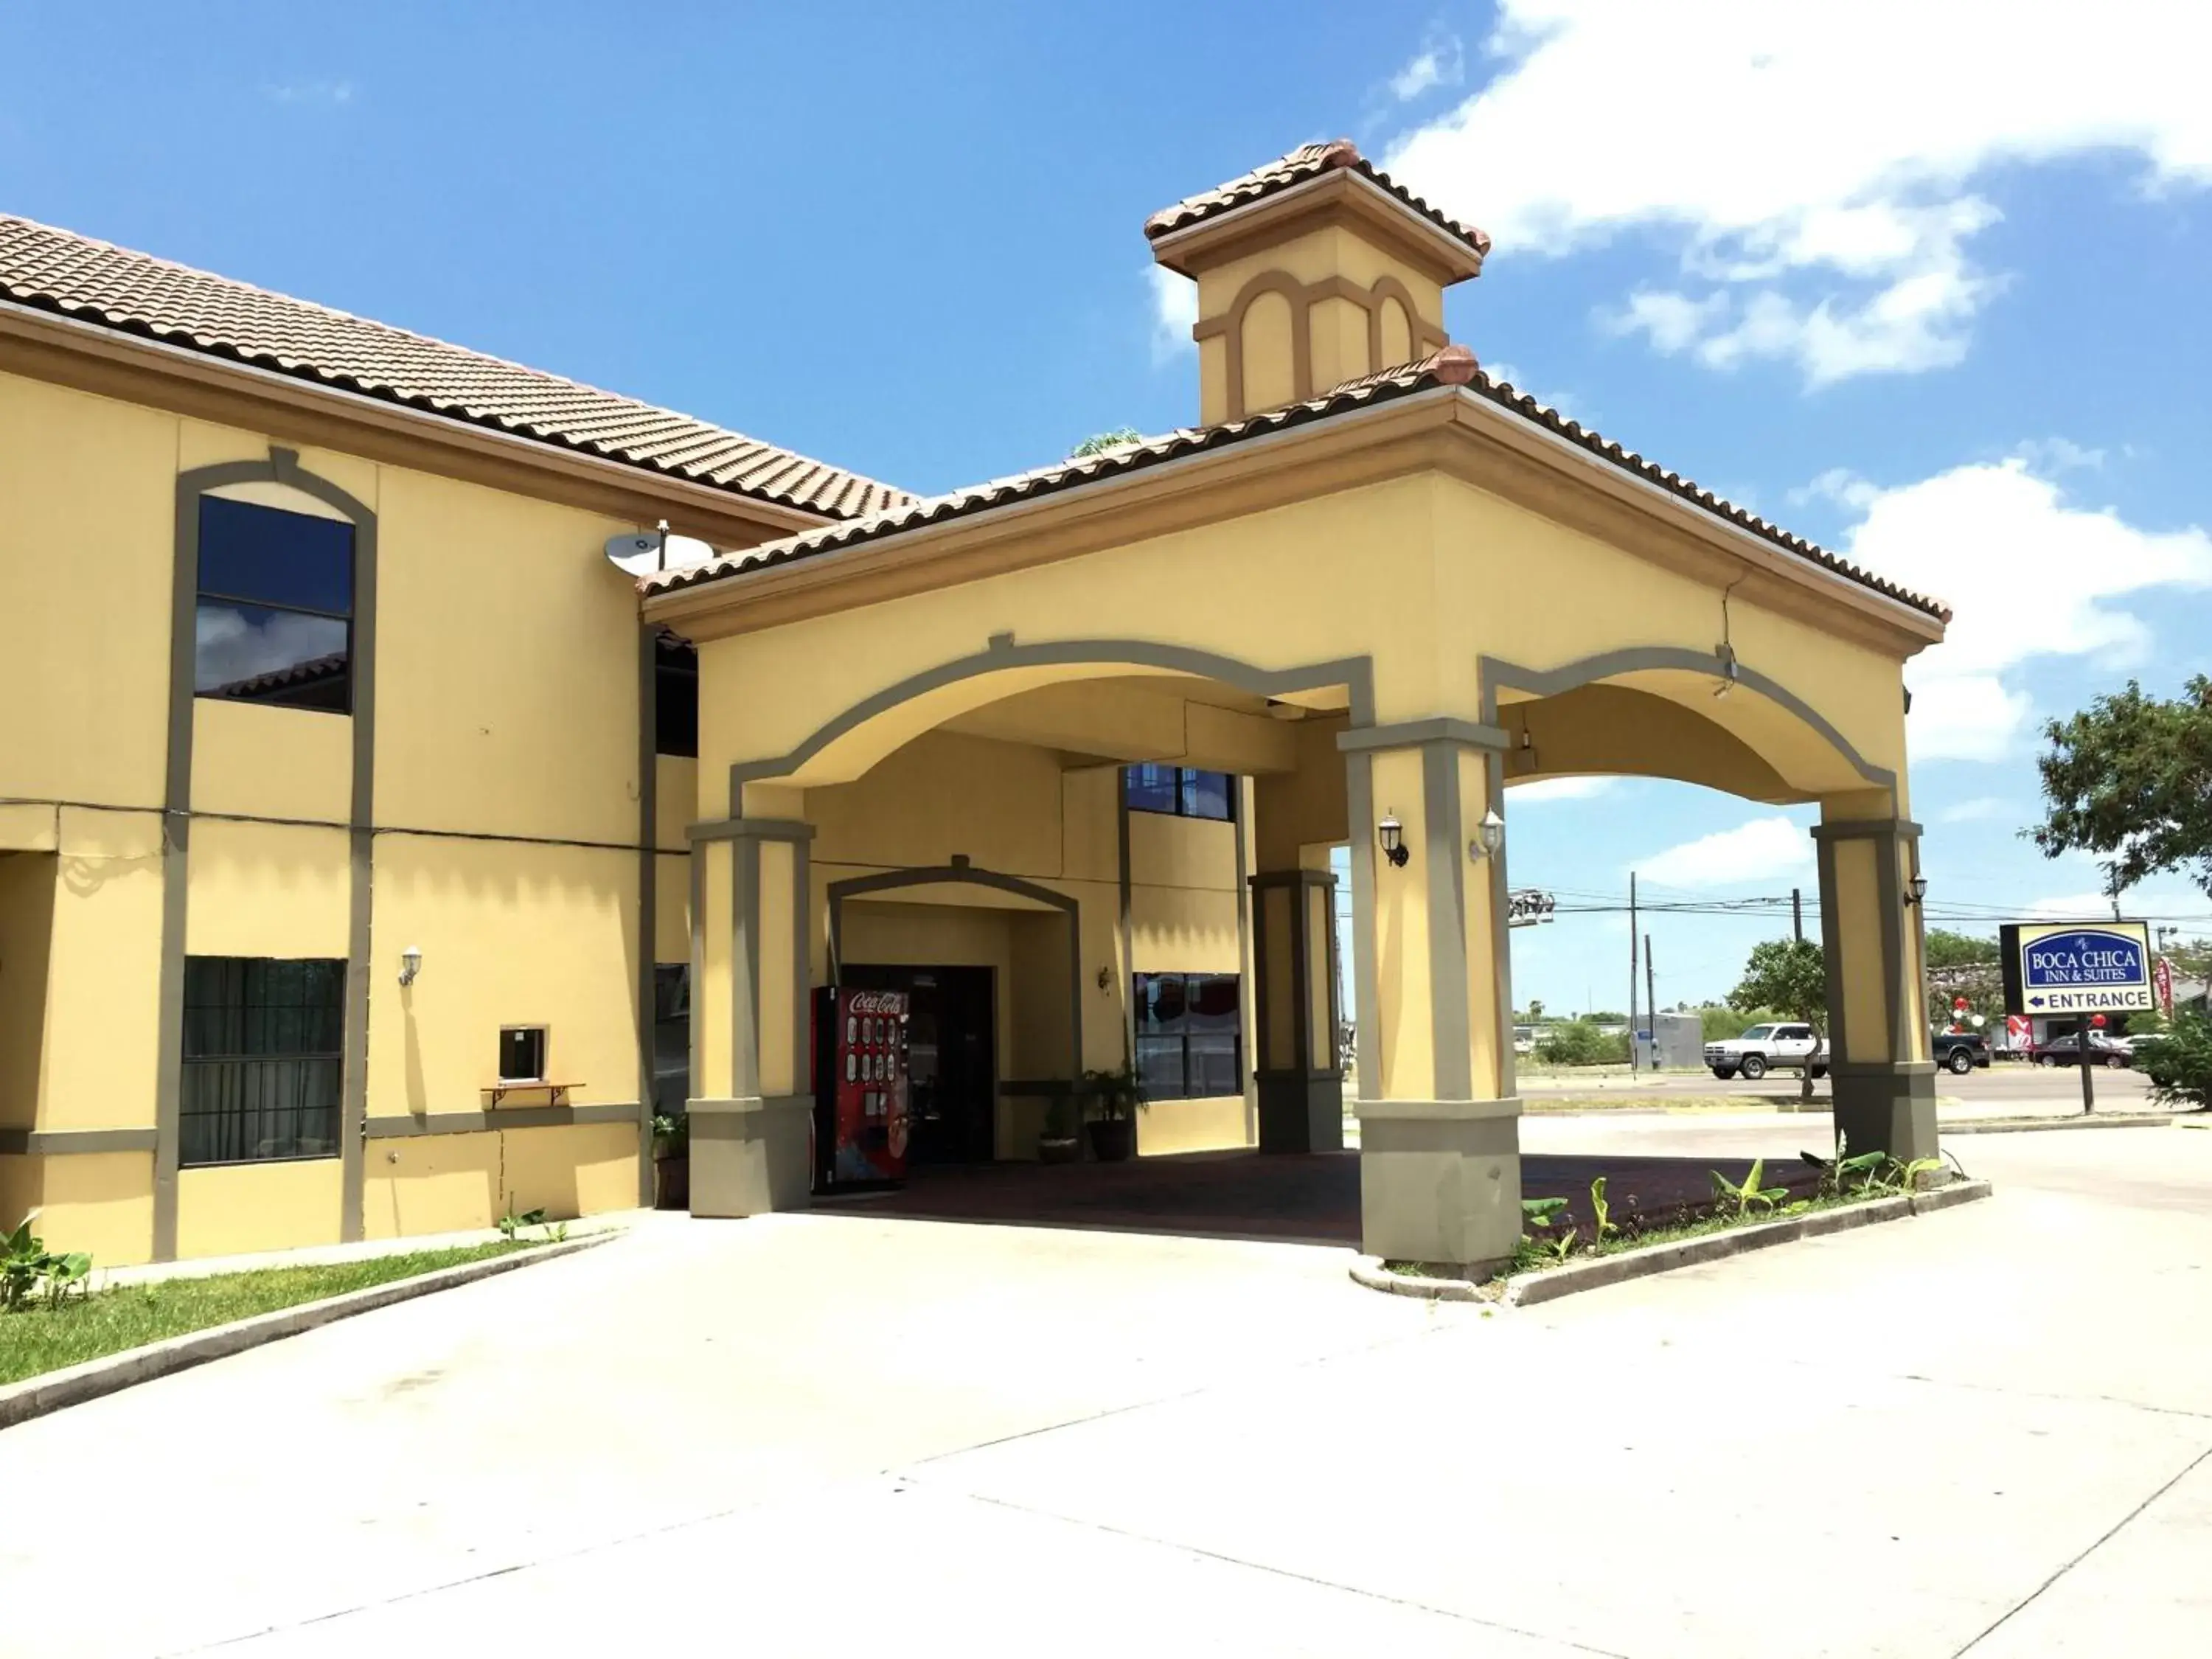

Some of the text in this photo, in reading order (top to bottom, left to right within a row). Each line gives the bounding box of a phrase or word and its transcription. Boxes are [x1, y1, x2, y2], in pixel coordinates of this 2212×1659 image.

[2032, 950, 2136, 970] BOCA CHICA
[2045, 968, 2126, 982] INN & SUITES
[2049, 991, 2149, 1009] ENTRANCE
